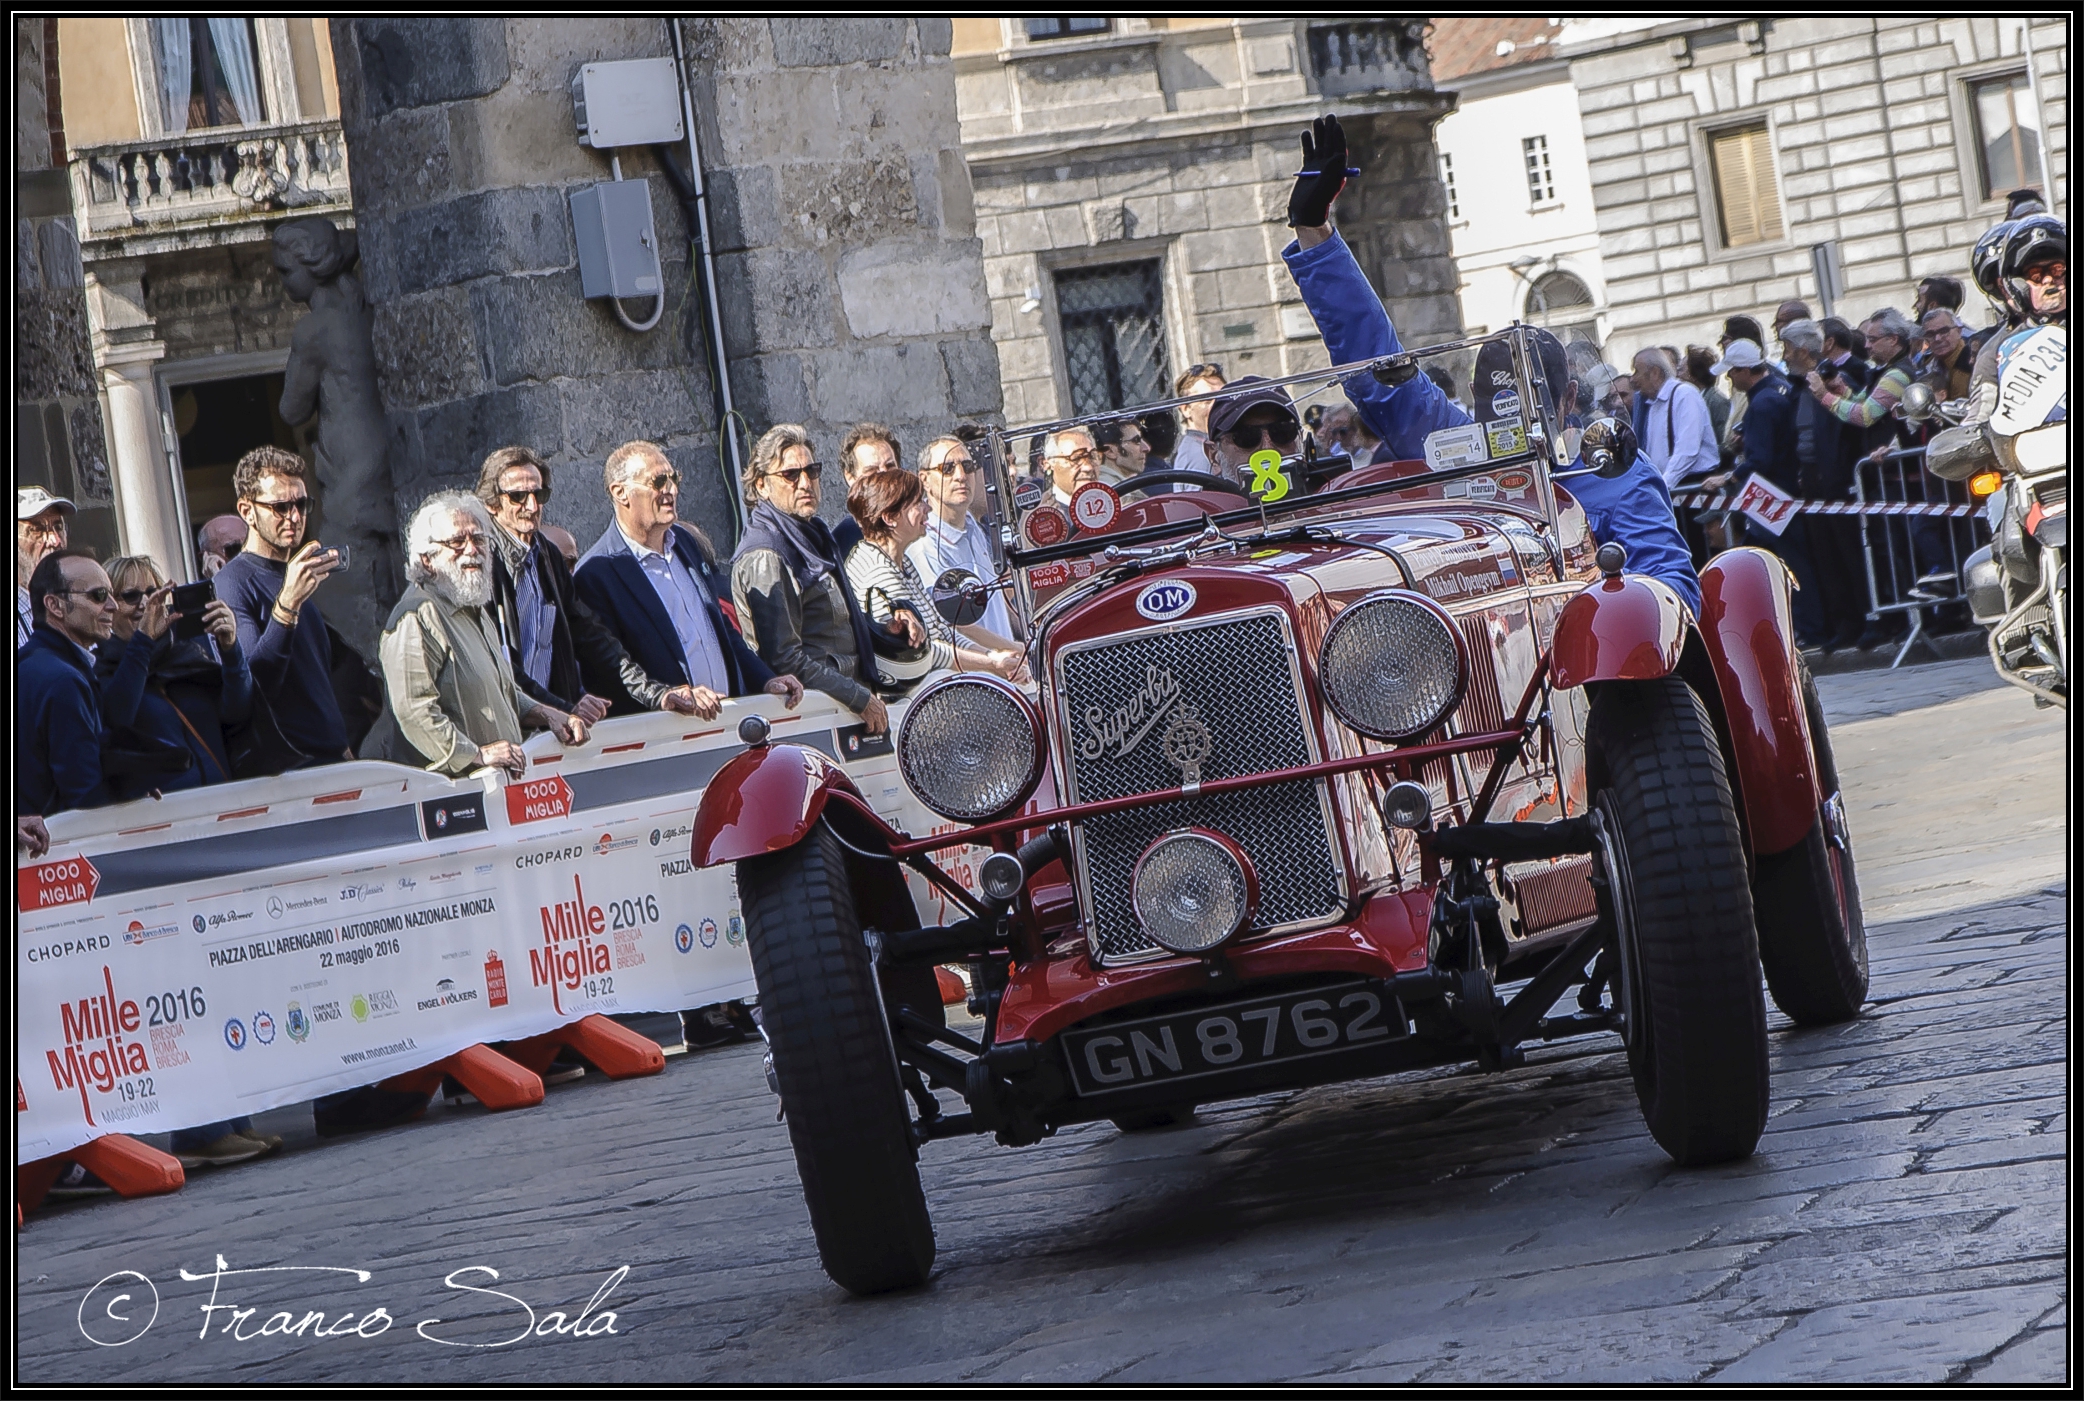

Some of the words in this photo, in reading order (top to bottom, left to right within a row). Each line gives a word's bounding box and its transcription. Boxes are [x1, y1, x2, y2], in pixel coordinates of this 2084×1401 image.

[1491, 371, 1518, 389] Chop
[2001, 367, 2047, 422] MEDIA
[2029, 337, 2066, 372] 234
[1434, 450, 1442, 461] 9
[1468, 442, 1481, 454] 14
[1249, 450, 1289, 502] 8
[1085, 499, 1106, 517] 12
[1411, 548, 1439, 568] Pavel
[1033, 566, 1059, 578] 1000
[1074, 563, 1092, 574] 2015
[1033, 577, 1063, 588] MIGLIA
[1425, 572, 1461, 599] Mikhail
[1148, 589, 1185, 612] OM
[1082, 665, 1181, 760] Superba
[524, 781, 558, 799] 1000
[525, 802, 565, 820] MIGLIA
[678, 825, 692, 836] Rom
[516, 845, 583, 869] CHOPARD
[37, 862, 81, 883] 1000
[661, 859, 693, 878] PIAZZA
[39, 883, 87, 906] MIGLIA
[286, 896, 329, 912] Mercedes-Benz
[540, 873, 606, 945] Mille
[609, 895, 660, 931] 2016
[208, 913, 226, 929] Alfa
[227, 910, 255, 922] Romeo
[209, 947, 248, 968] PIAZZA
[249, 928, 335, 960] DELL'ARENGARIO
[341, 915, 404, 942] AUTODROMO
[405, 904, 460, 931] NAZIONALE
[460, 897, 496, 920] MONZA
[613, 929, 643, 945] BRESCIA
[28, 935, 111, 963] CHOPARD
[320, 952, 335, 969] 22
[336, 945, 374, 966] maggio
[375, 939, 401, 958] 2016
[616, 942, 637, 957] ROMA
[617, 952, 646, 970] BRESCIA
[487, 968, 504, 978] RADIO
[529, 937, 612, 1016] Miglia
[488, 979, 505, 988] MONTE
[583, 977, 615, 999] 19-22
[490, 988, 507, 1000] CARLO
[60, 964, 141, 1045] Mille
[146, 986, 207, 1027] 2016
[314, 1009, 343, 1024] MONZA
[149, 1024, 185, 1043] BRESCIA
[1084, 1026, 1183, 1084] GN
[1196, 991, 1389, 1065] 8762
[152, 1040, 178, 1057] ROMA
[341, 1038, 418, 1065] www.monzanet.it
[156, 1051, 192, 1070] BRESCIA
[46, 1041, 150, 1128] Miglia
[118, 1078, 156, 1103] 19-22
